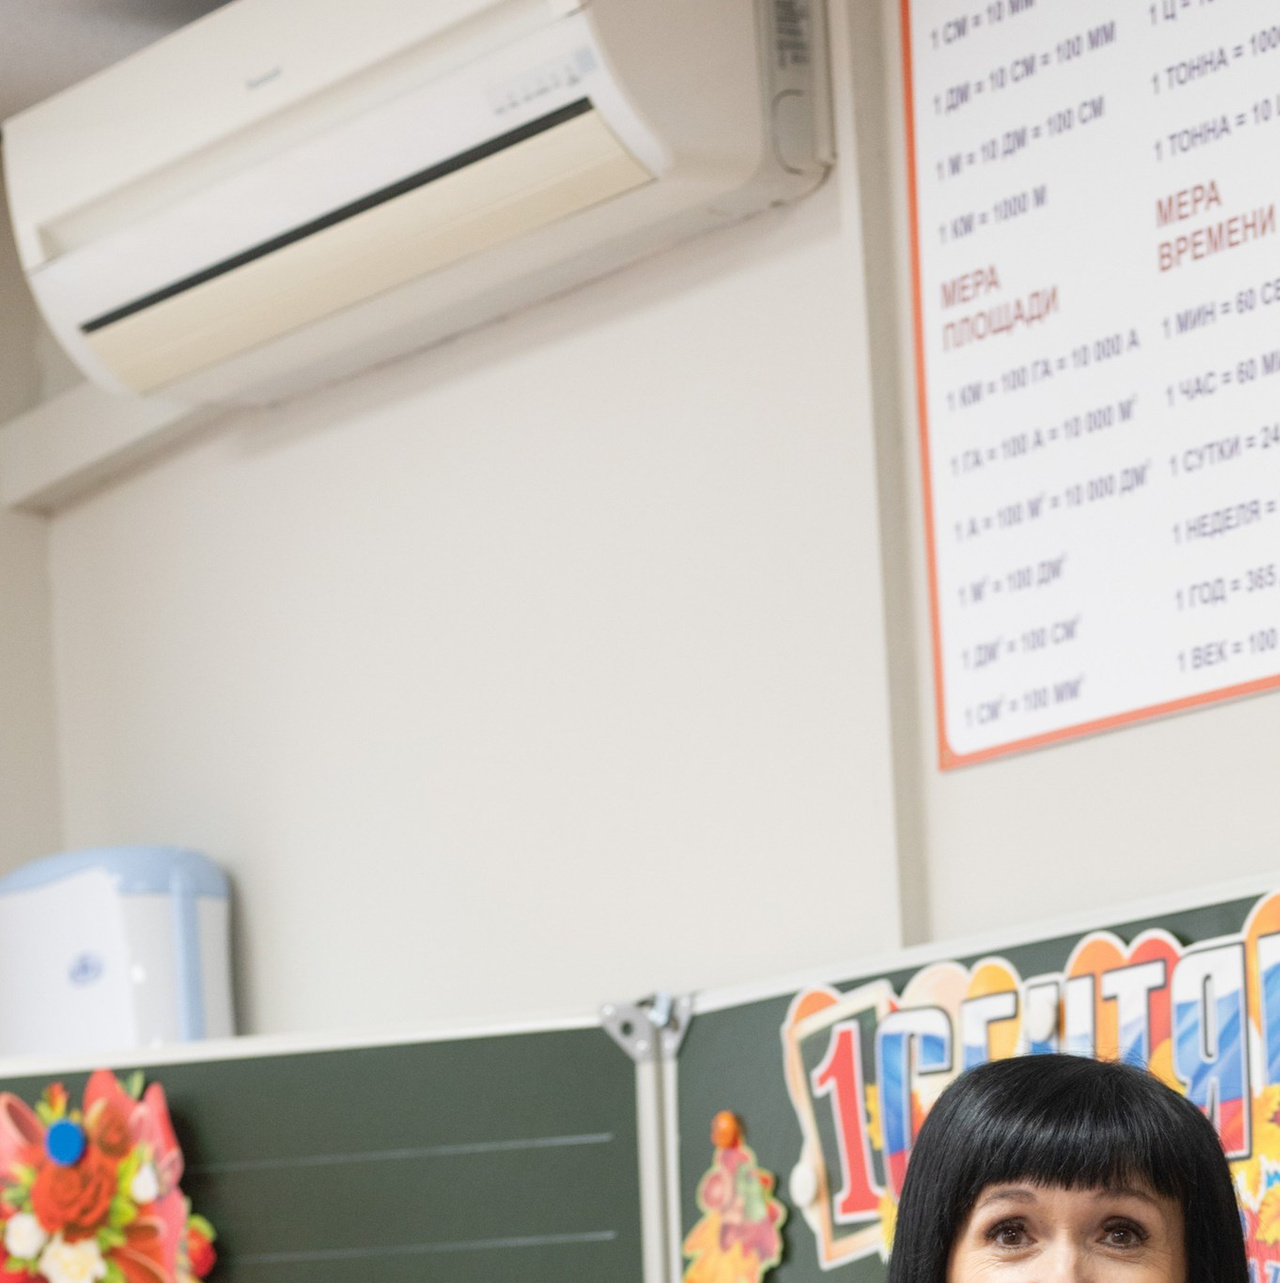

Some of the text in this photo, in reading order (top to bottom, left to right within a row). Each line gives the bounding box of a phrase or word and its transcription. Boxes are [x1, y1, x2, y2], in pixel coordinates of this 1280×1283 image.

[1164, 46, 1229, 88] ТОННА
[1167, 114, 1231, 154] ТОННА
[1252, 98, 1272, 123] 10
[1155, 180, 1223, 228] МЕРА
[1157, 204, 1277, 273] ВРЕМЕНИ
[939, 266, 1001, 308] МЕРА
[1180, 370, 1216, 400] ЧАС
[1183, 435, 1240, 472] СУТКИ
[1260, 423, 1280, 449] 24
[1186, 498, 1260, 539] НЕДЕЛЯ
[1189, 576, 1226, 606] ГОД
[1246, 563, 1275, 592] 365
[1191, 640, 1227, 670] ВЕК
[1248, 626, 1278, 652] 100
[810, 1020, 883, 1225] 1
